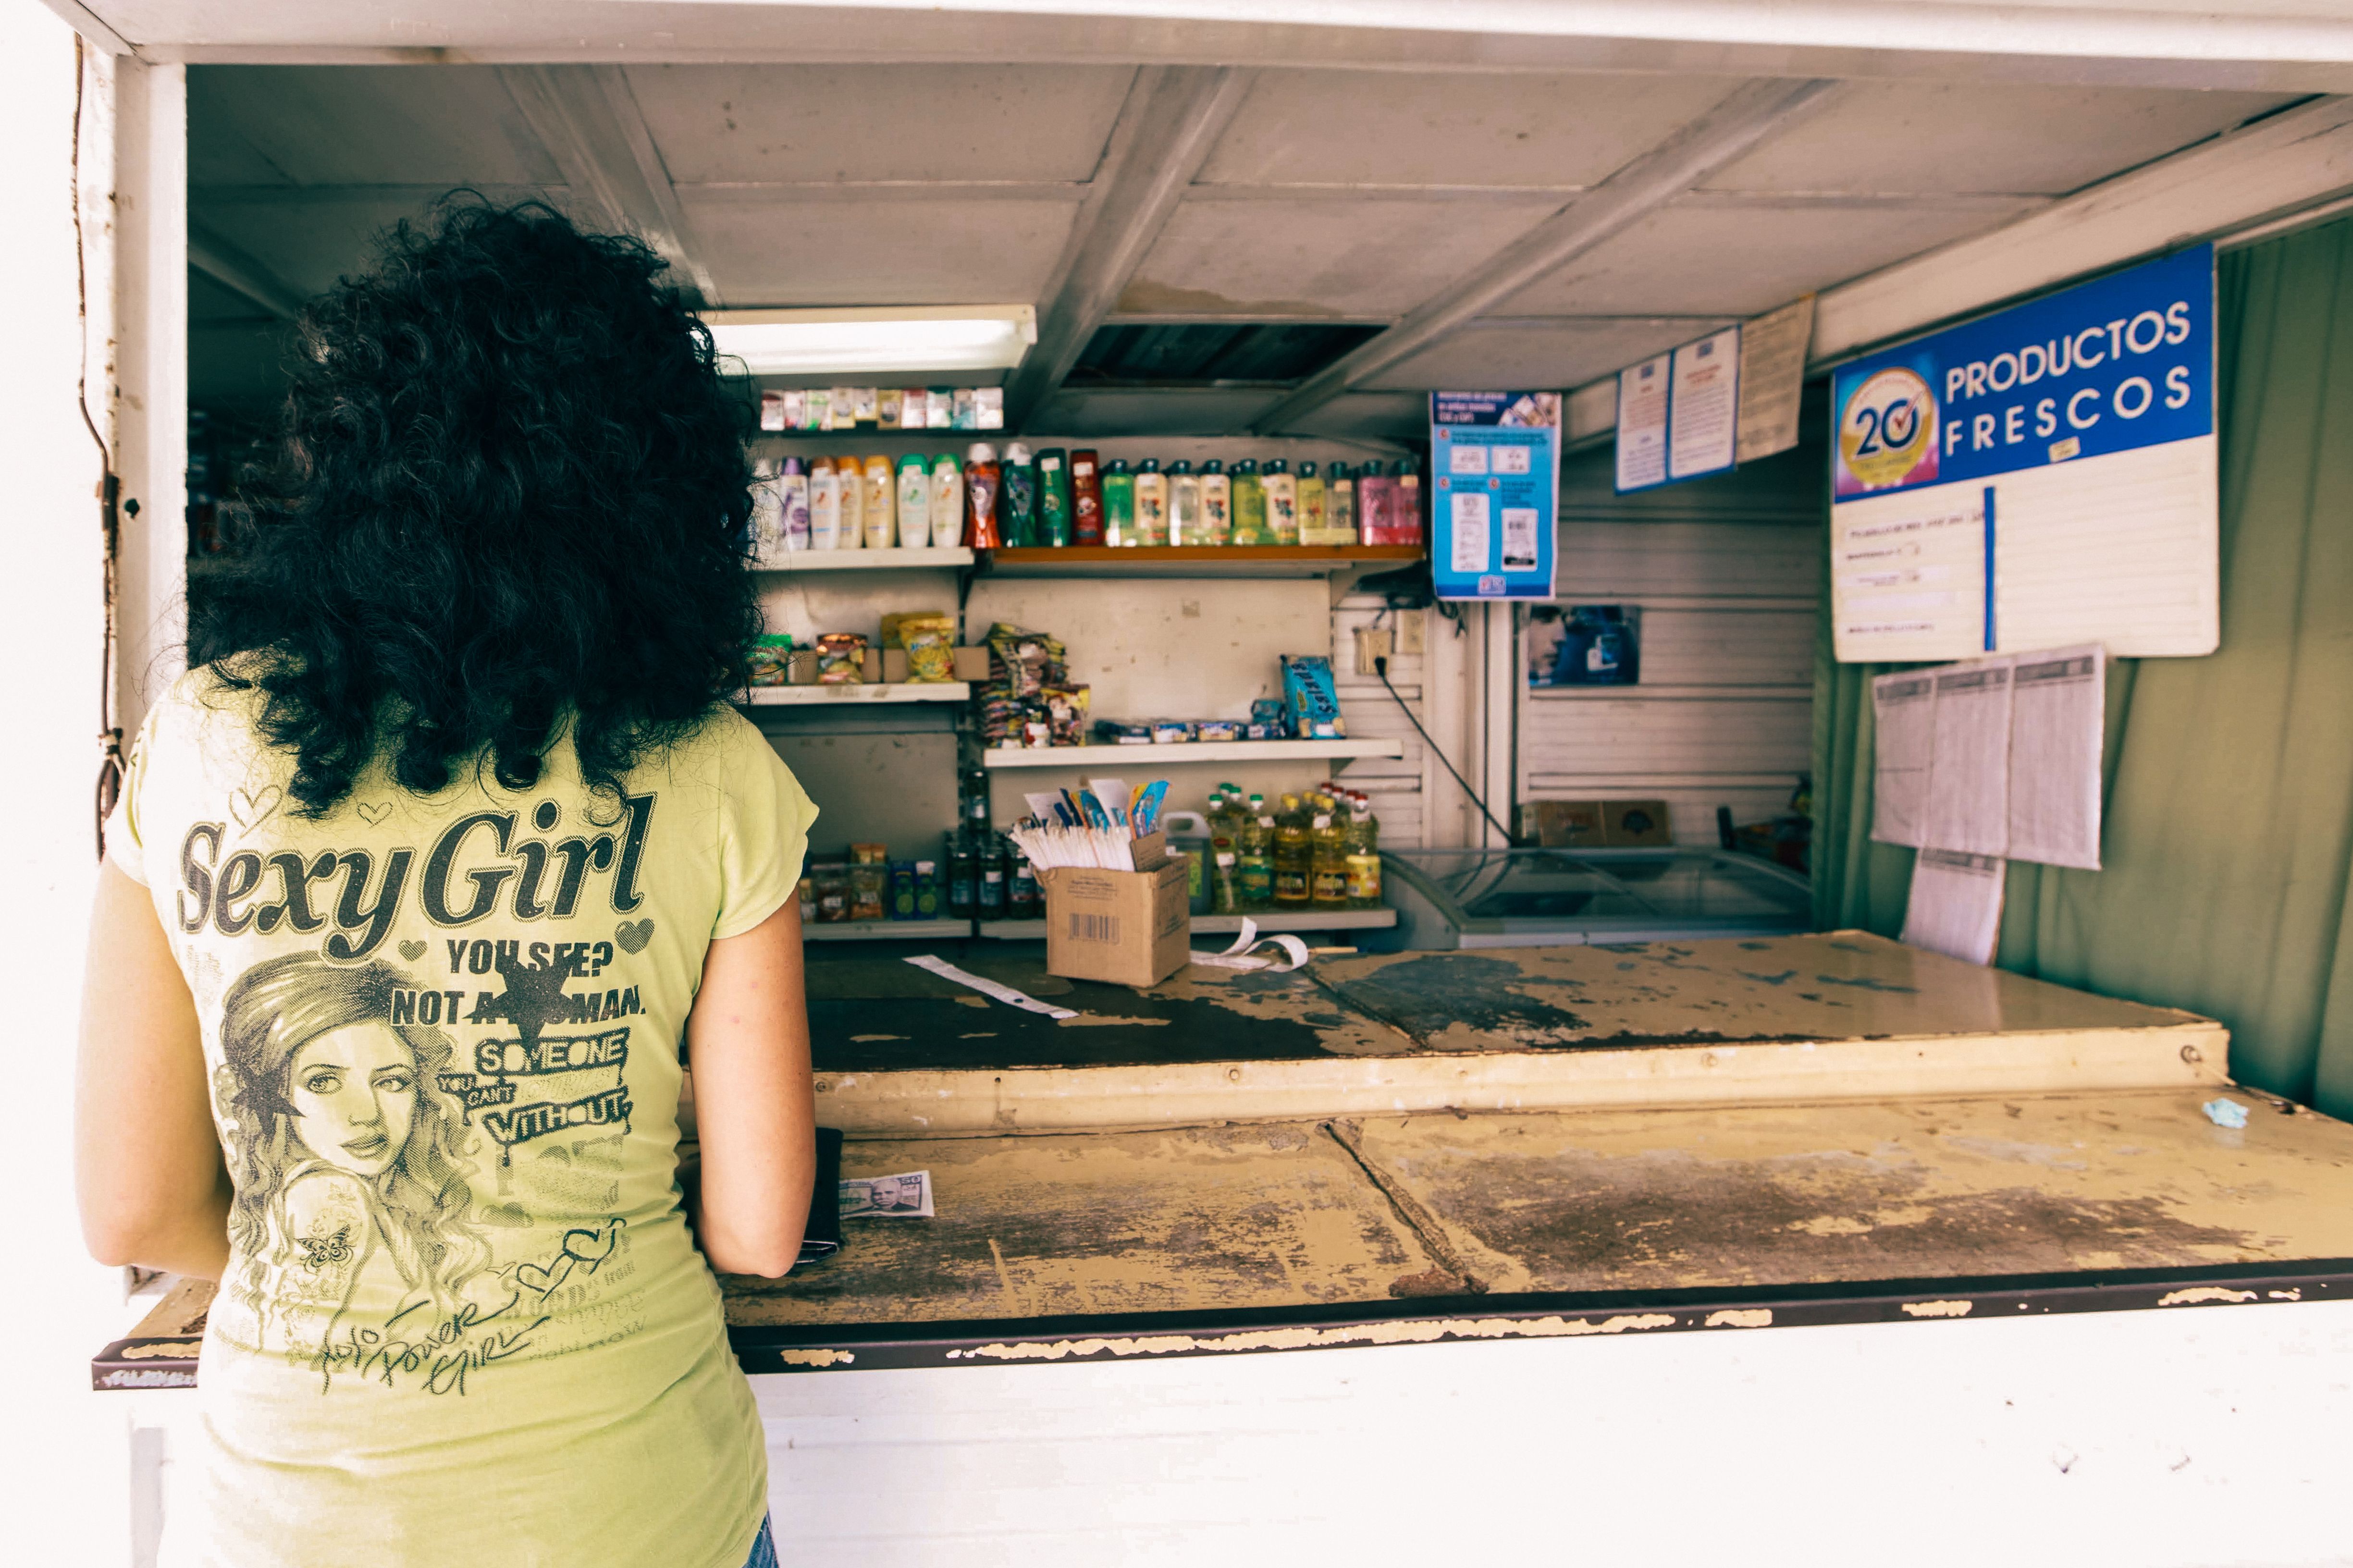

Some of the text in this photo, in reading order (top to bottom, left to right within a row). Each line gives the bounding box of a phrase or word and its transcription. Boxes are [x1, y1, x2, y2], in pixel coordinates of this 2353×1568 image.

[1946, 301, 2191, 404] PRODUCTOS
[1856, 398, 1919, 456] 20
[1946, 365, 2191, 457] FRESCOS
[176, 791, 658, 968] Sexy Girl
[447, 939, 520, 975] YOU
[392, 990, 465, 1025] NOT
[480, 1033, 625, 1073] SOMEONE
